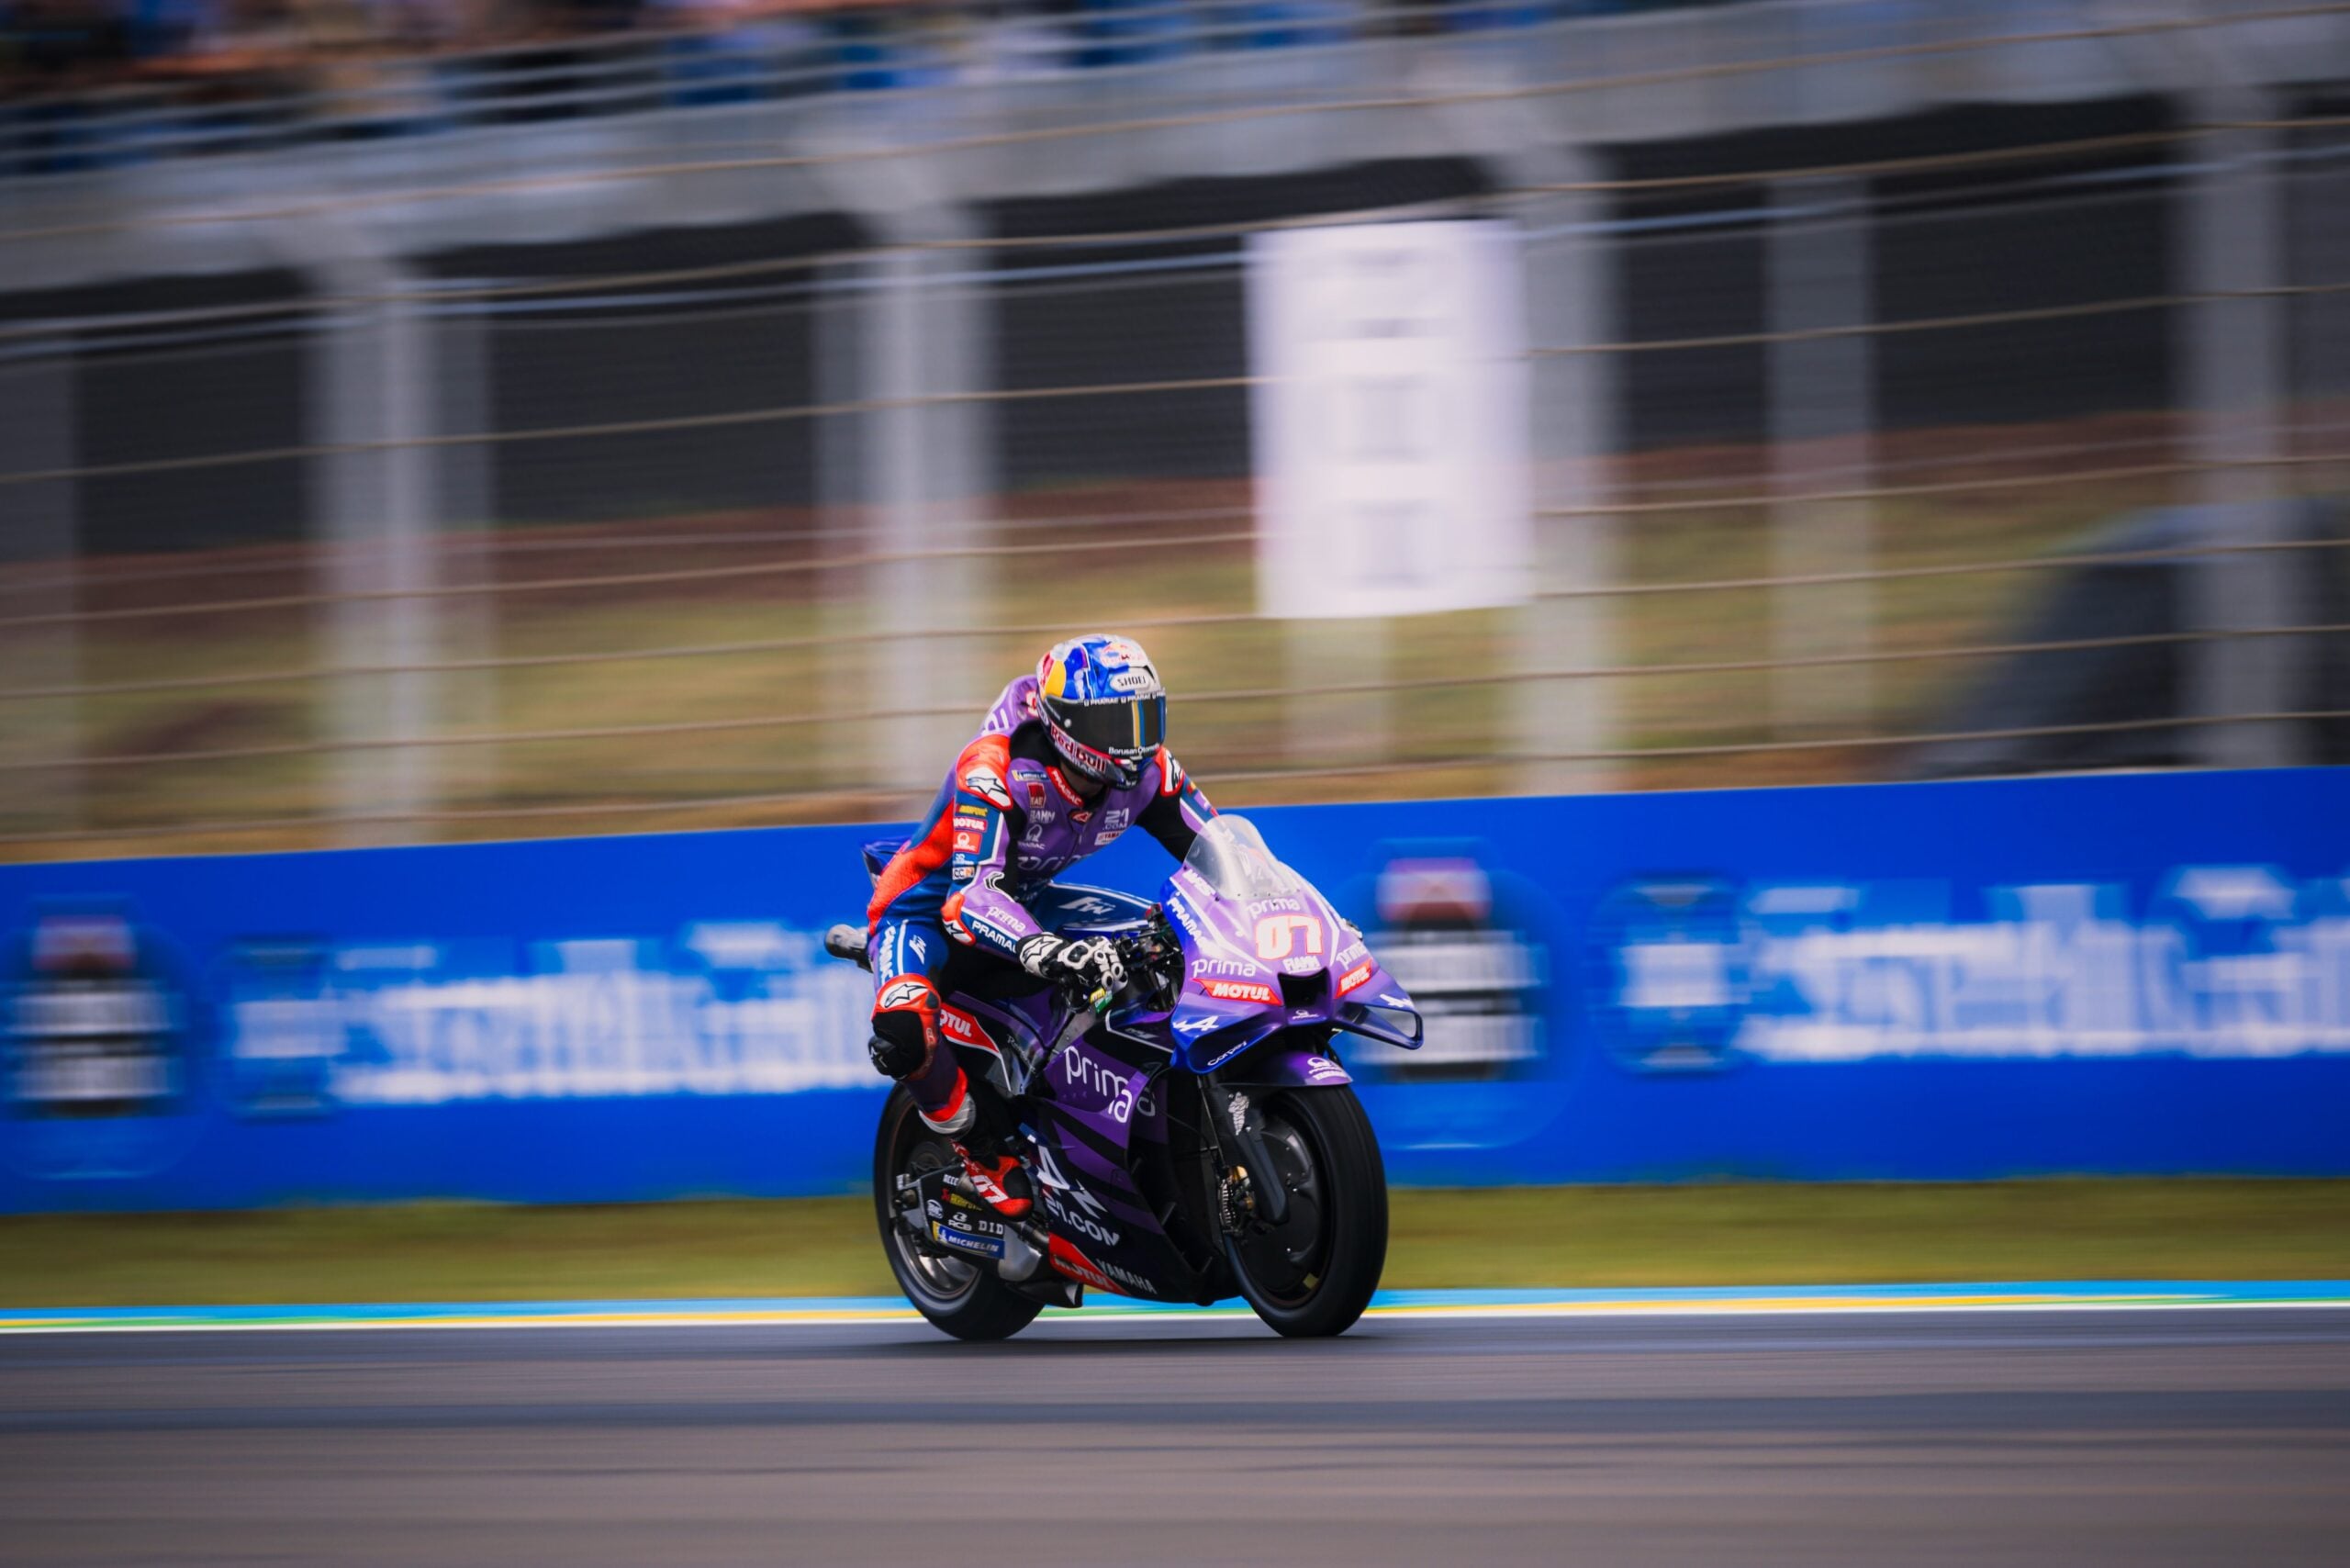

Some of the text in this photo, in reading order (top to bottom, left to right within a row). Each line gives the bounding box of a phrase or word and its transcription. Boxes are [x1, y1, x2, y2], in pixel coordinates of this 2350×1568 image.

[1051, 723, 1075, 754] Red
[1248, 898, 1301, 920] prima
[1255, 913, 1323, 960] 07
[1192, 958, 1257, 979] prima
[1212, 983, 1270, 1001] MOTUL
[940, 1009, 972, 1037] OTUL
[948, 1235, 999, 1251] MICHELIN
[1097, 1259, 1158, 1294] YAMAHA
